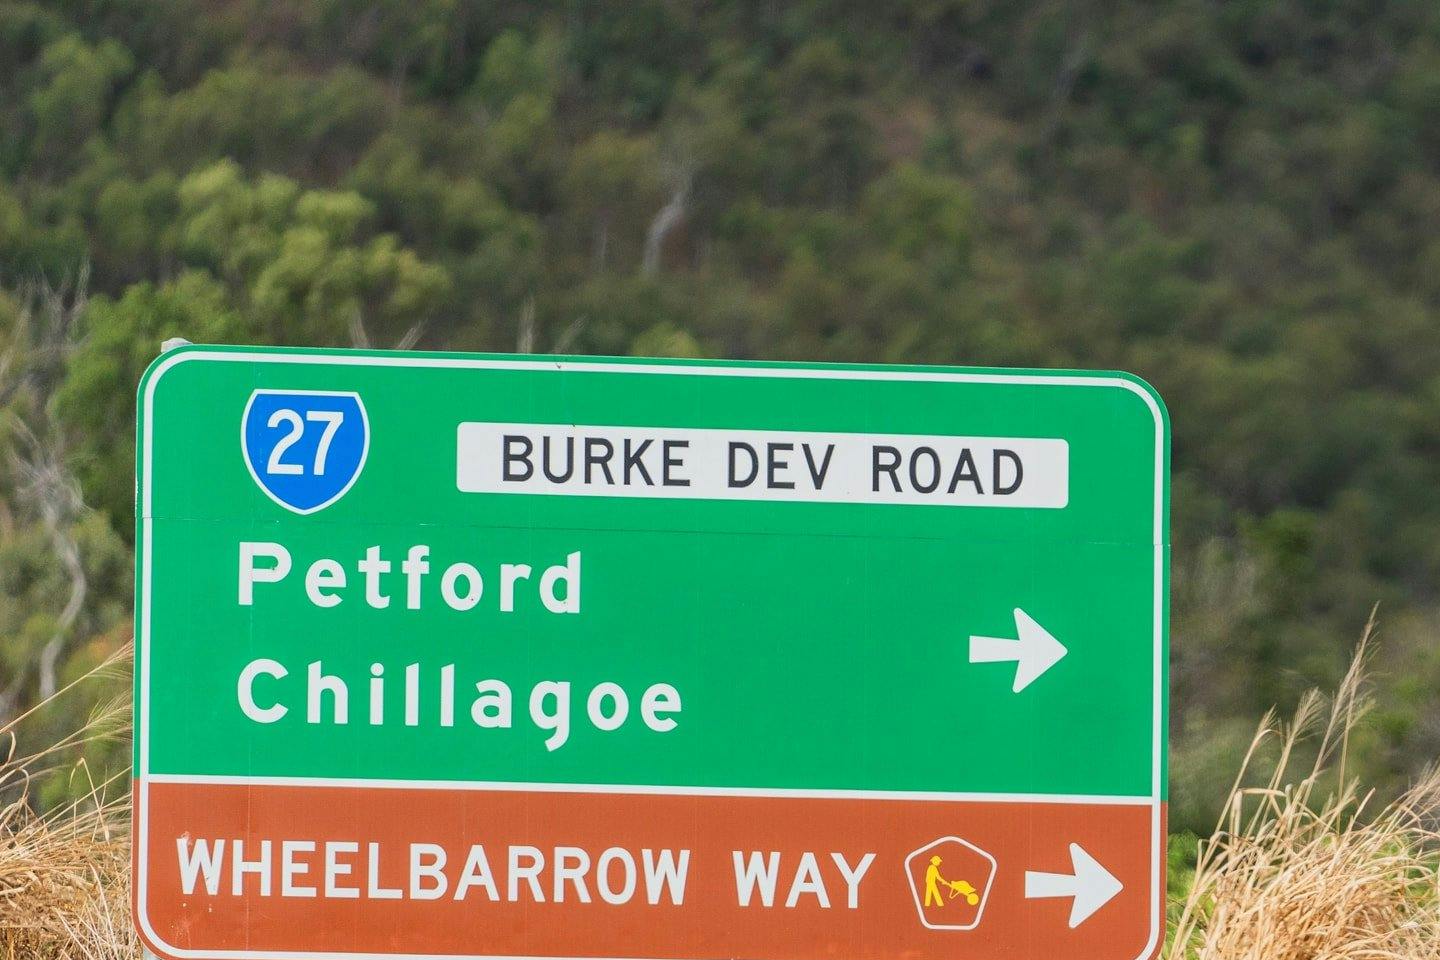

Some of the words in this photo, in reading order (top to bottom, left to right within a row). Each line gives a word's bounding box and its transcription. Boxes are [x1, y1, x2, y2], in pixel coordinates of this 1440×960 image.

[267, 409, 343, 475] 27
[503, 435, 690, 486] BURKE
[728, 442, 835, 490] DEV
[873, 446, 1023, 495] ROAD
[239, 542, 580, 613] Petford
[238, 659, 681, 751] Chillagoe
[177, 837, 690, 905] WHEELBARROW
[733, 851, 876, 908] WAY
